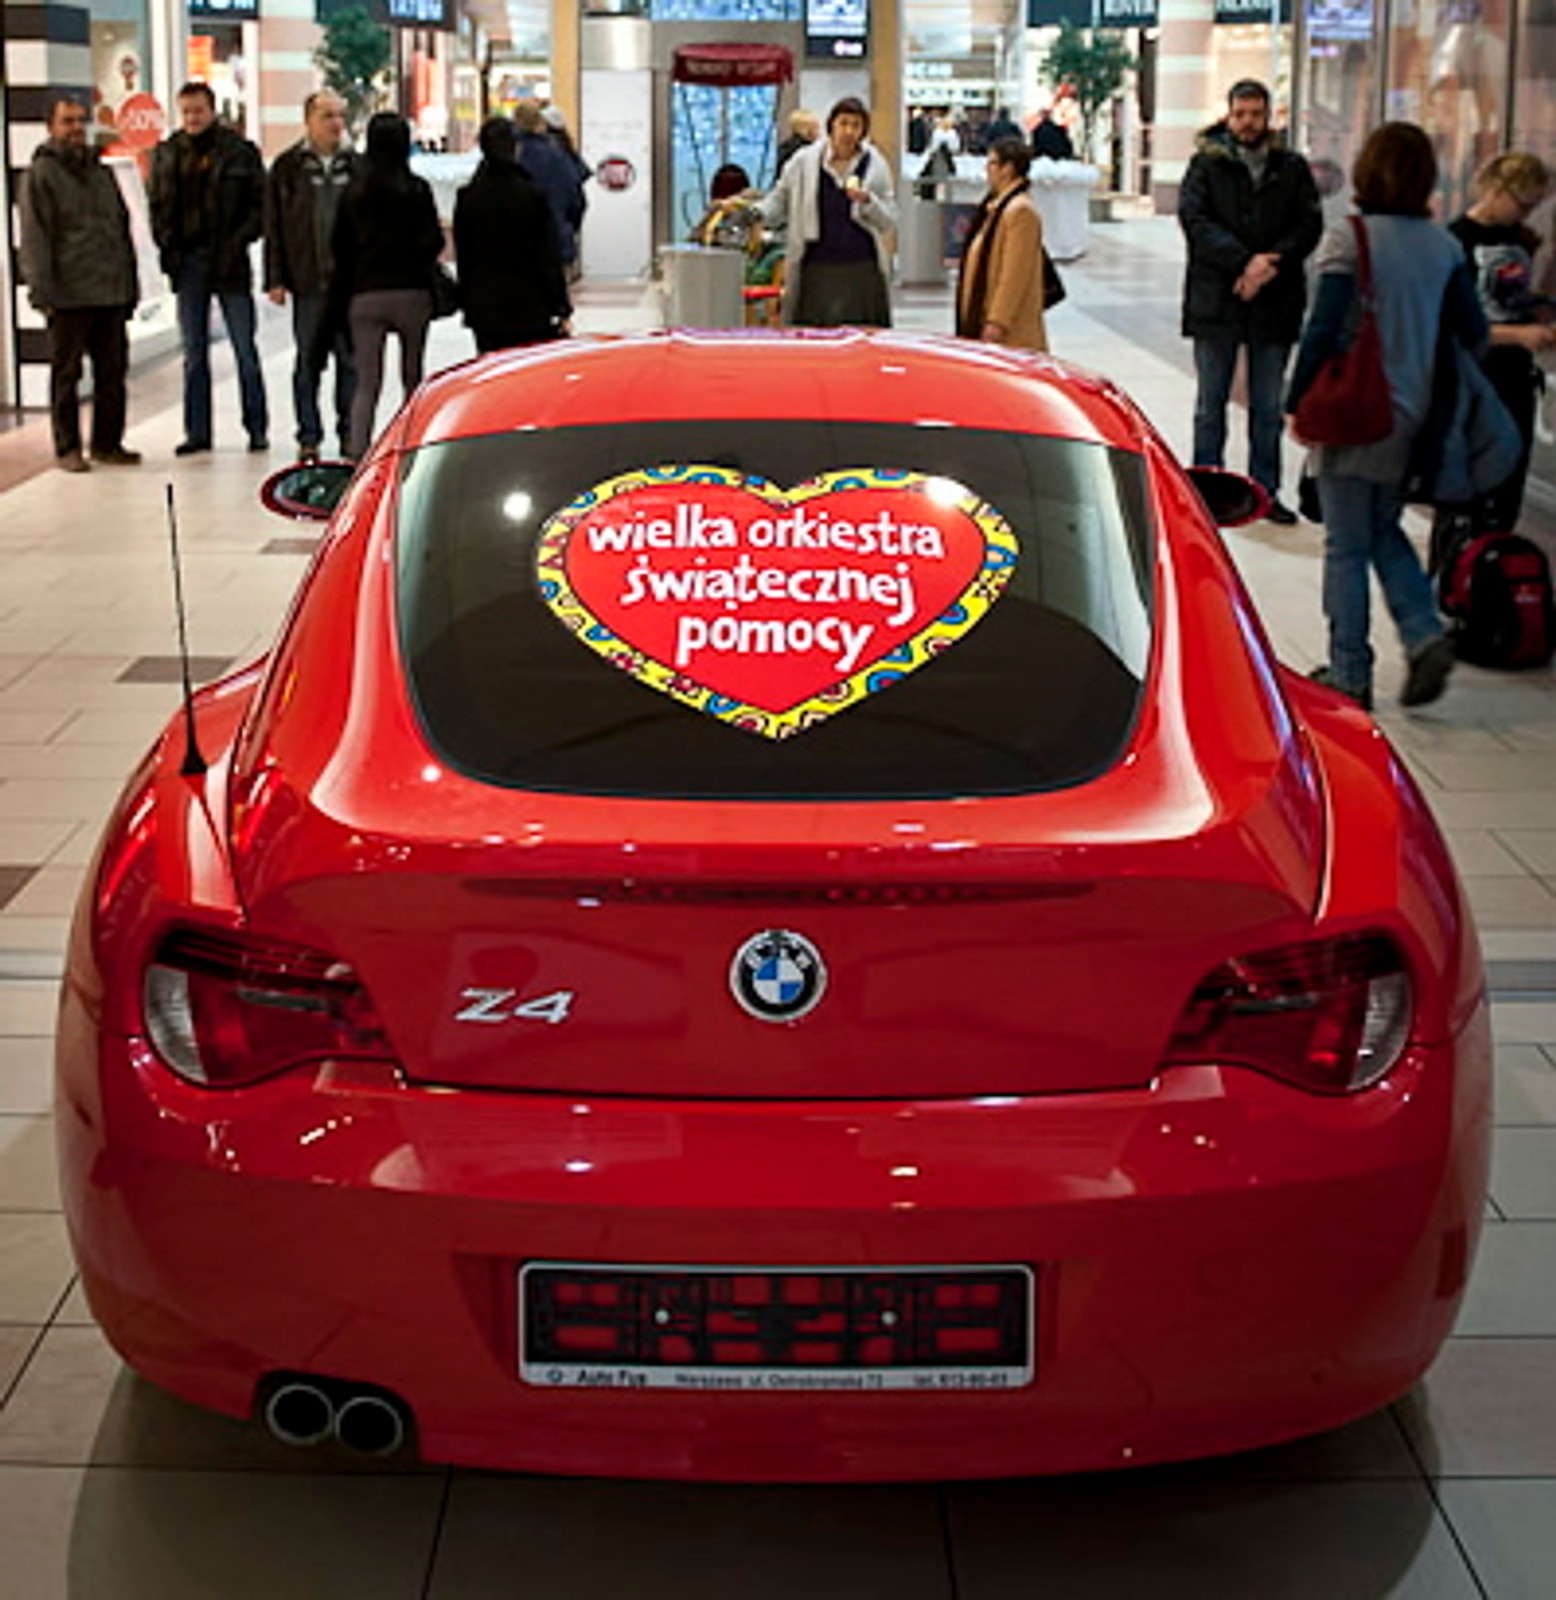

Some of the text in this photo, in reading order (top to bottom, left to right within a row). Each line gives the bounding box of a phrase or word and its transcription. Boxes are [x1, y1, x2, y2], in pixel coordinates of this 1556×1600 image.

[588, 504, 944, 558] wielka orkiestra
[621, 555, 914, 627] świątecznej
[676, 615, 873, 671] pomocy
[454, 987, 574, 1024] Z4
